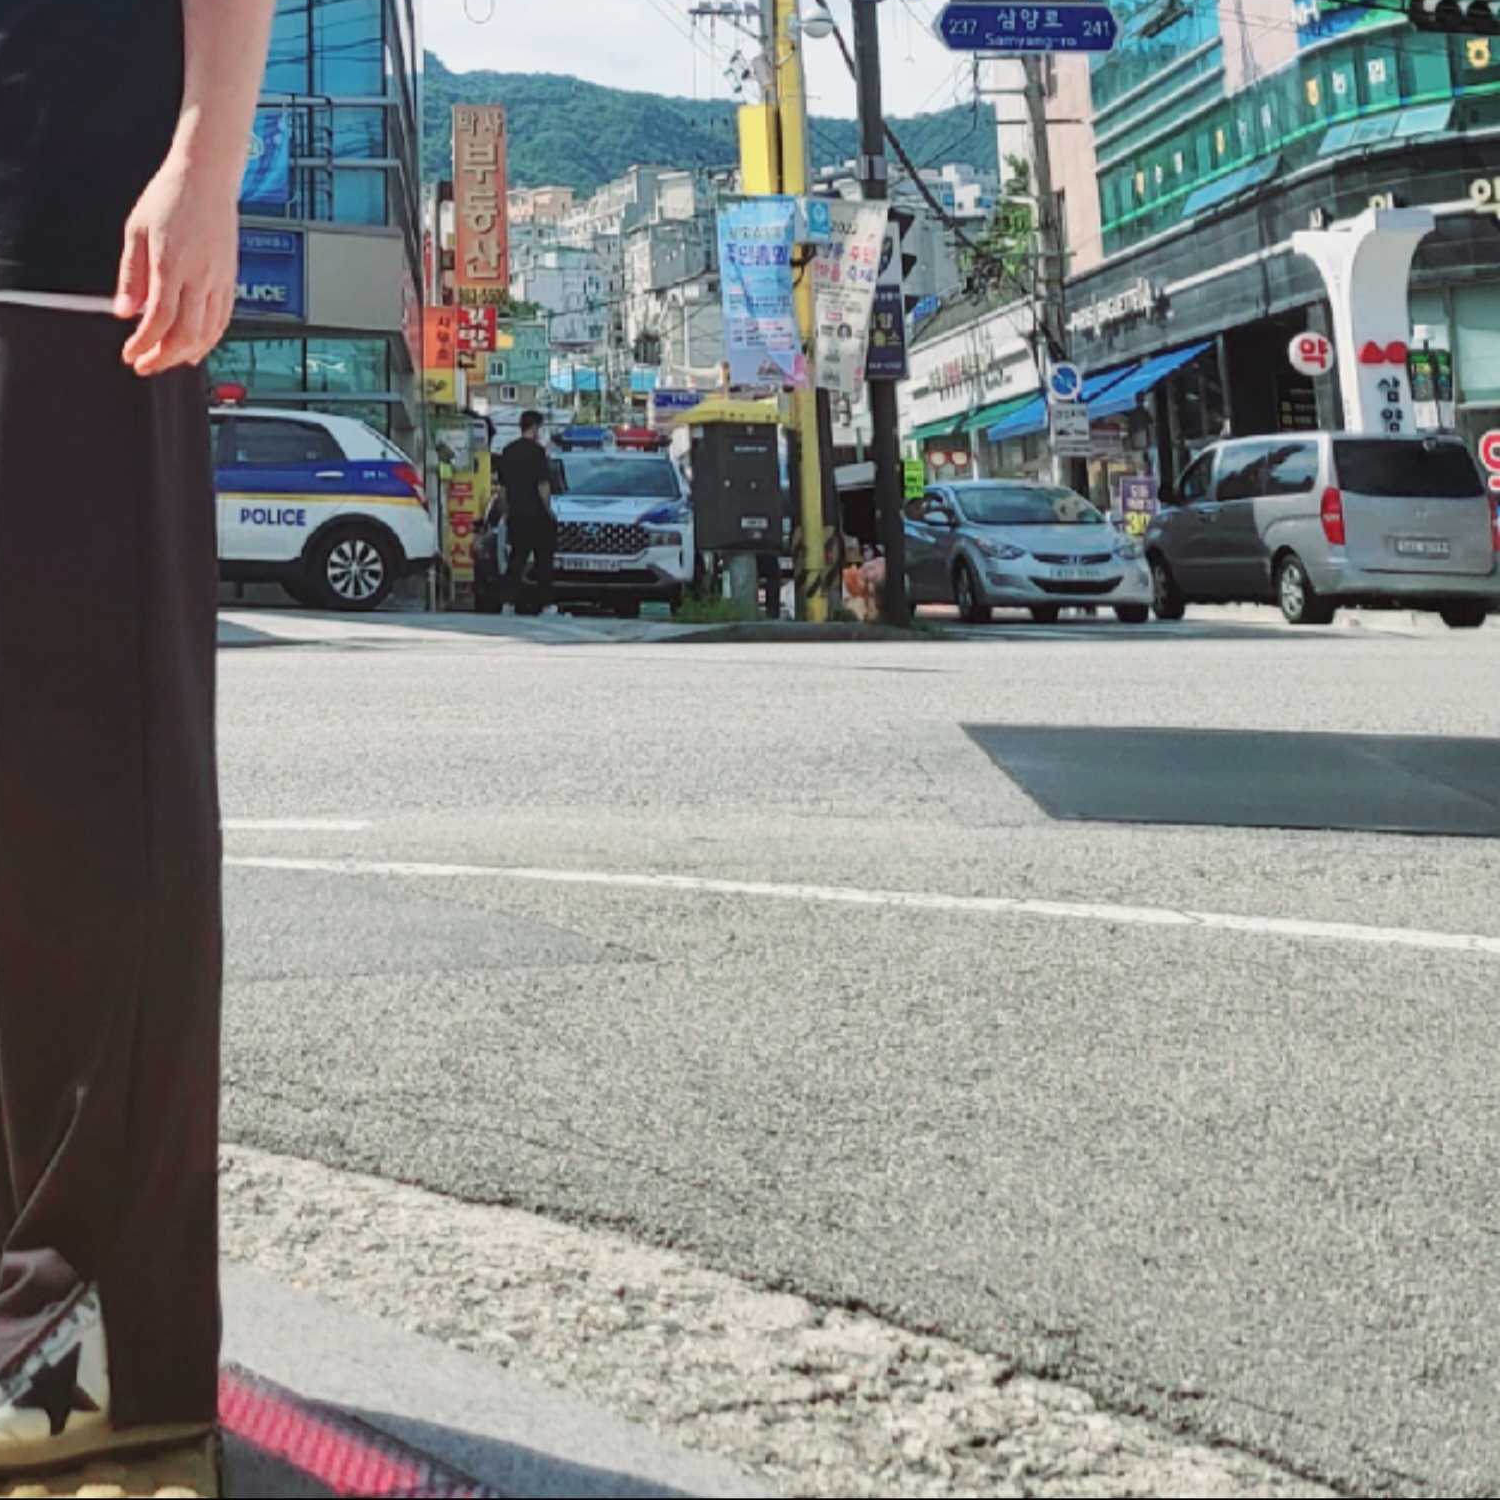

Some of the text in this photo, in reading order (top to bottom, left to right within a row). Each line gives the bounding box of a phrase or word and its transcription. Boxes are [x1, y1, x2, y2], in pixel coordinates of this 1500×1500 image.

[950, 8, 1111, 37] 237 삼양로 241
[985, 33, 1077, 49] Samyang-ro
[462, 142, 501, 279] 부동산
[1299, 338, 1331, 368] 약
[240, 508, 306, 526] POLICE
